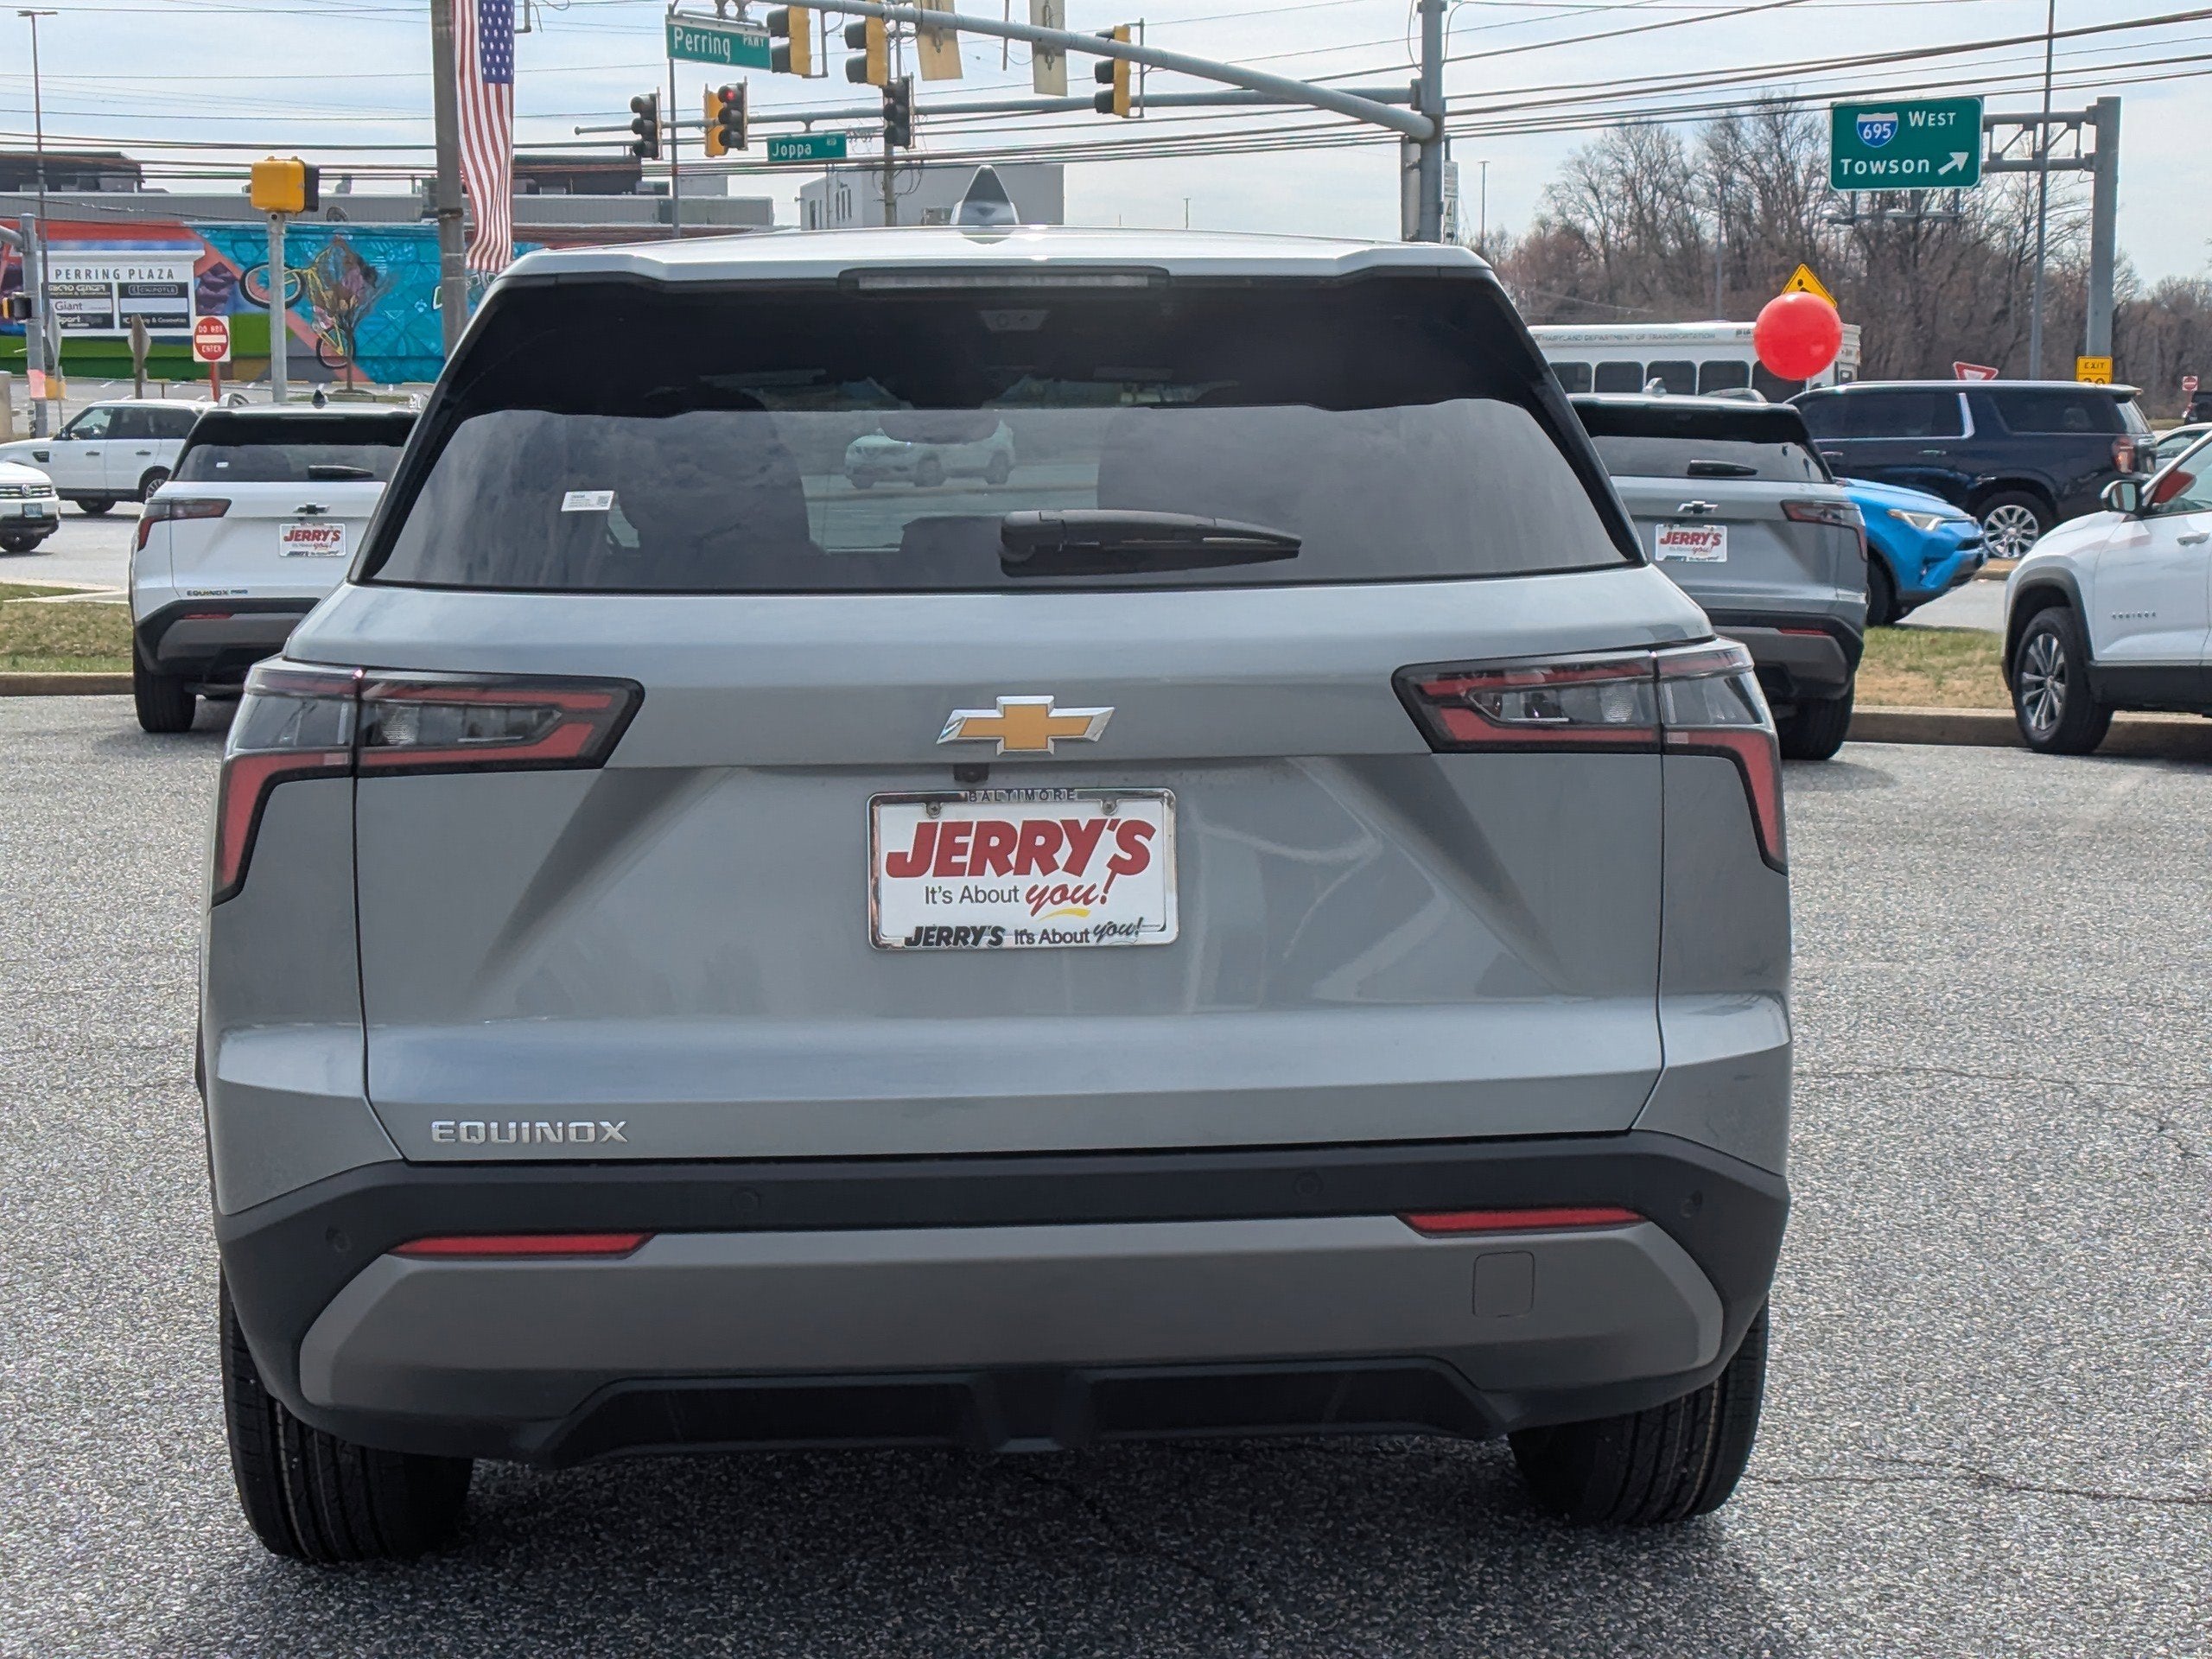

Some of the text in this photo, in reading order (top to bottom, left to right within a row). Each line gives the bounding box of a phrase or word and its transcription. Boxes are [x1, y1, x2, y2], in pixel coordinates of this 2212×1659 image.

[673, 26, 765, 63] Perring PKWY
[1863, 111, 1956, 140] 695 WEST
[772, 143, 812, 159] Joppa
[55, 269, 175, 280] PERRING PLAZA
[54, 301, 82, 311] Giant
[199, 325, 207, 334] DO
[283, 529, 341, 542] JERRY'S
[1660, 531, 1723, 546] JERRY'S
[969, 788, 1076, 803] BALTIMORE
[885, 817, 1157, 879] JERRY'S
[925, 871, 1117, 918] It's About you!
[904, 917, 1144, 947] JERRY'S It's About you!
[431, 1121, 628, 1144] EQUINOX
